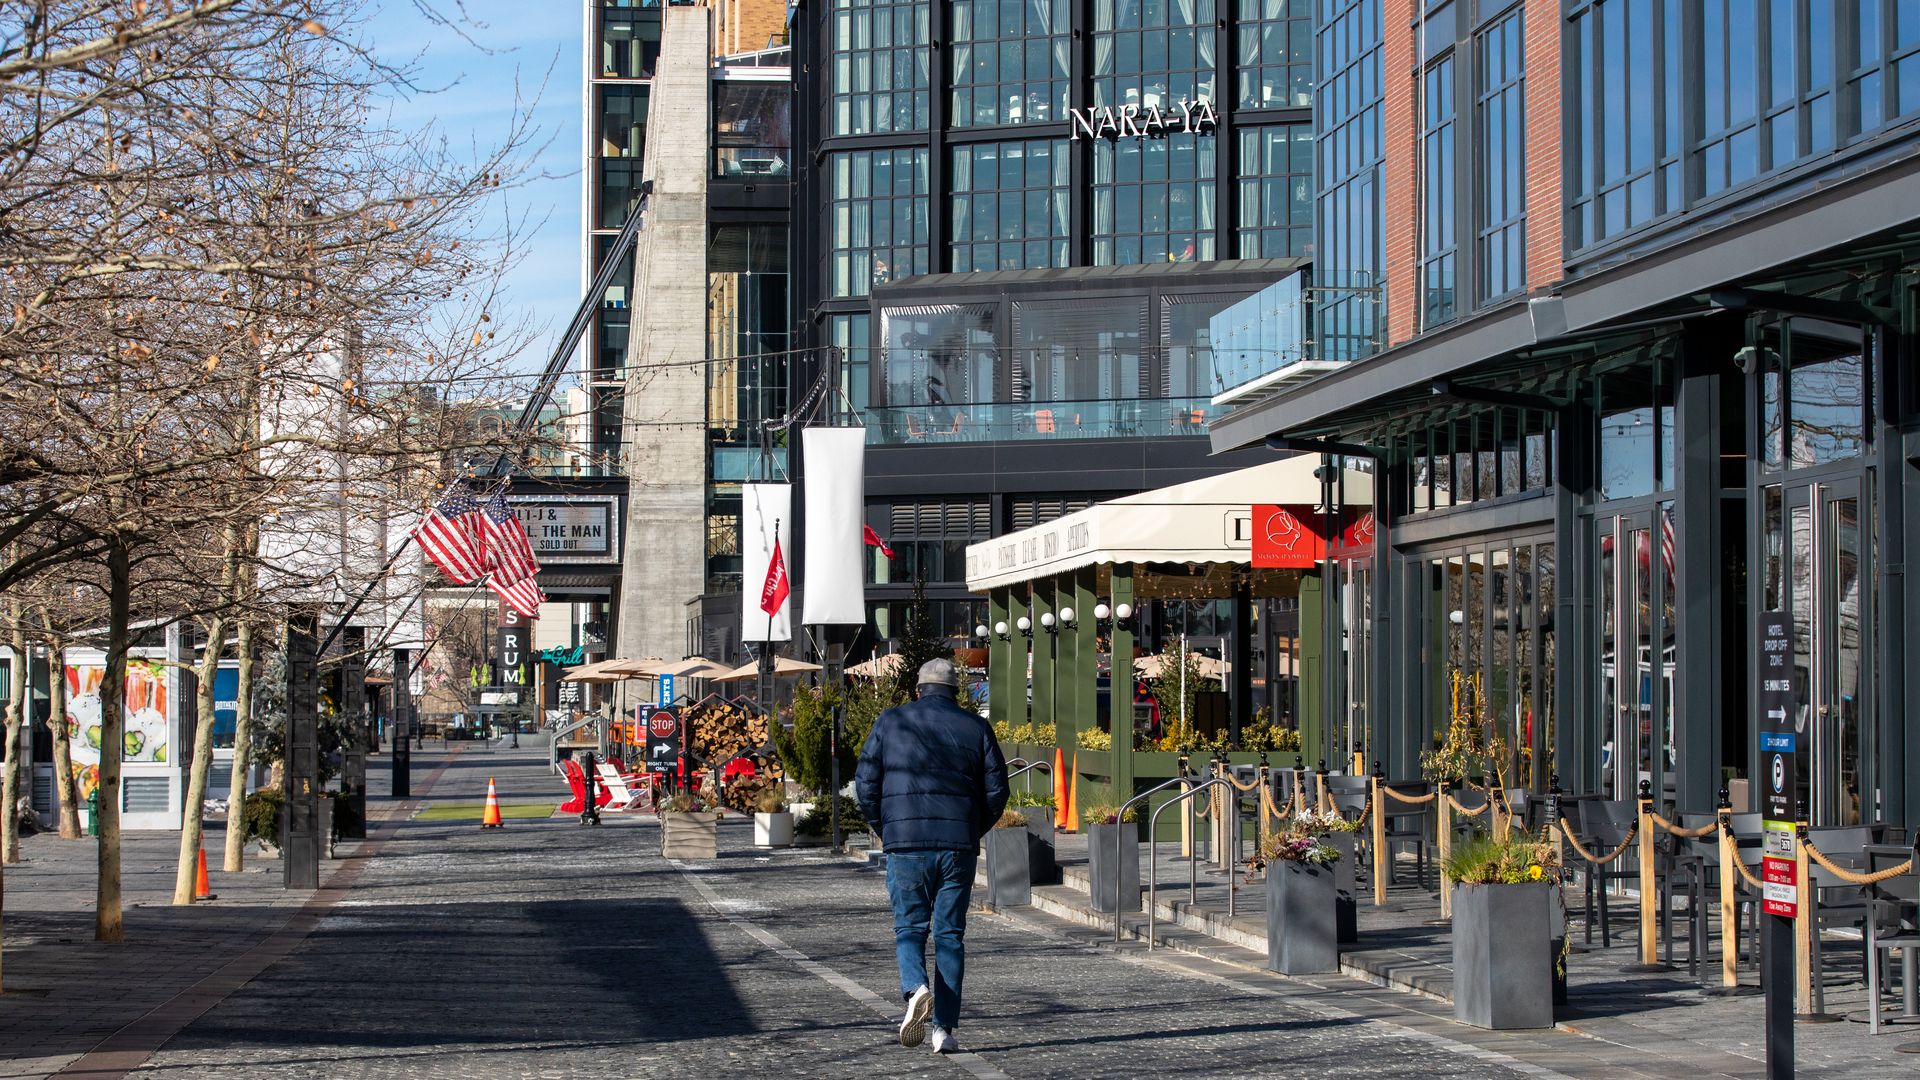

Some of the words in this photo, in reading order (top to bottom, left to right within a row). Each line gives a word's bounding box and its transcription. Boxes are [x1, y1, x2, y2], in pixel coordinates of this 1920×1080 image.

[1070, 100, 1217, 140] NARA-YA
[547, 508, 557, 521] &
[542, 525, 566, 538] THE
[571, 525, 601, 538] MAN
[540, 539, 561, 550] SOLD
[563, 539, 578, 550] OUT
[1767, 624, 1784, 636] HOTEL
[1764, 639, 1778, 651] DROP
[1778, 639, 1788, 651] OFF
[503, 634, 519, 683] RUM
[551, 644, 585, 667] Grill
[1769, 654, 1783, 666] ZONE
[1769, 679, 1790, 691] MINUTES
[651, 719, 674, 730] STOP
[1769, 861, 1775, 870] NO
[1774, 862, 1790, 872] PARKING
[1783, 903, 1792, 912] Zone
